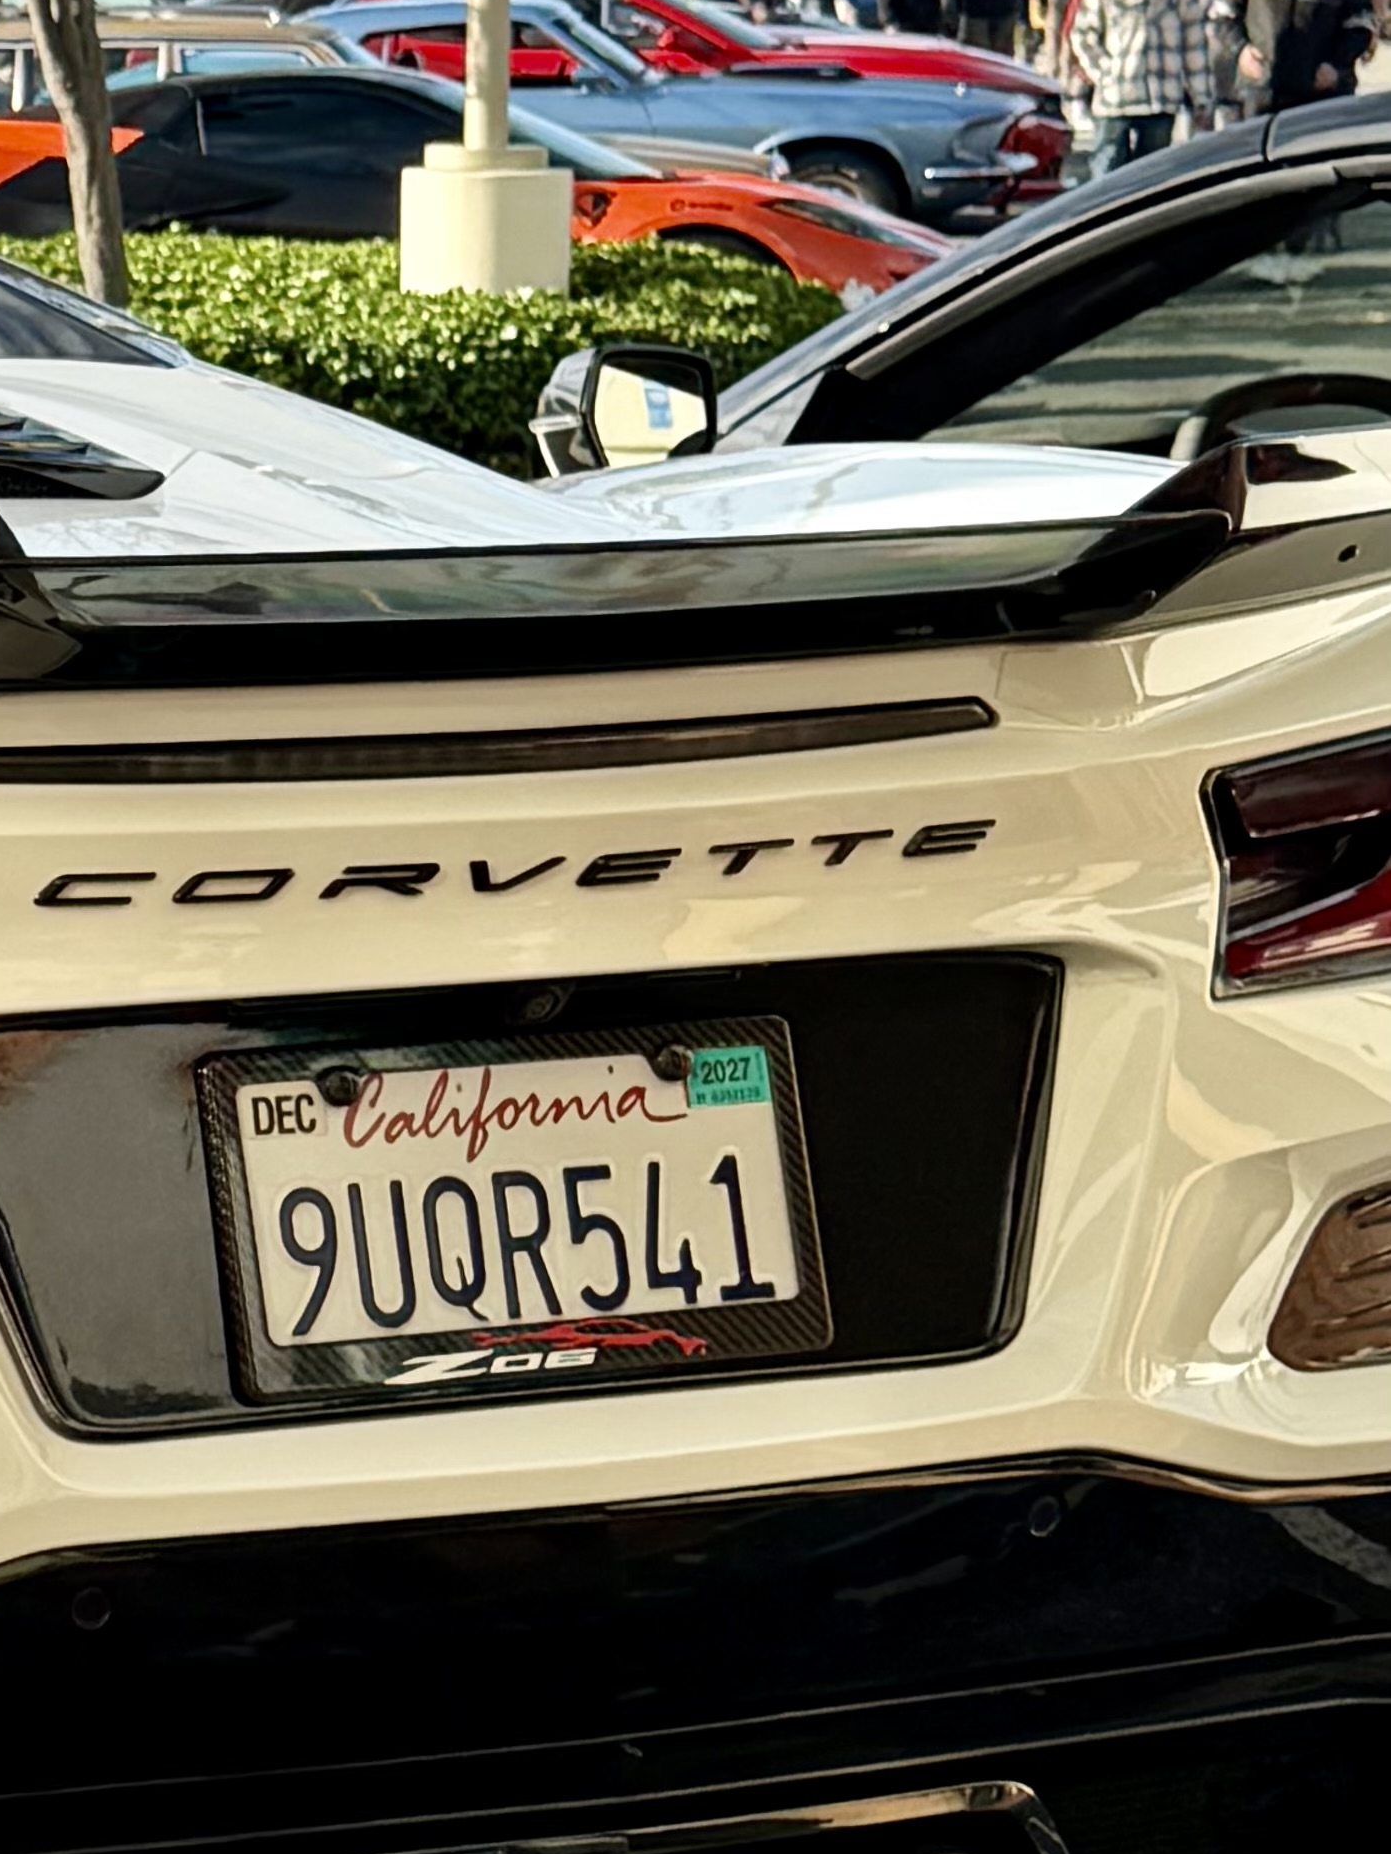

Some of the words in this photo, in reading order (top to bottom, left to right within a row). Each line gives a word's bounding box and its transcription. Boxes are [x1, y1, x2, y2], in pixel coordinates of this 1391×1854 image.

[33, 819, 997, 907] CORVETTE
[701, 1056, 751, 1085] 2027
[251, 1094, 317, 1138] DEC
[343, 1065, 688, 1162] California
[279, 1154, 775, 1338] 9UQR541
[383, 1347, 598, 1385] Z06
